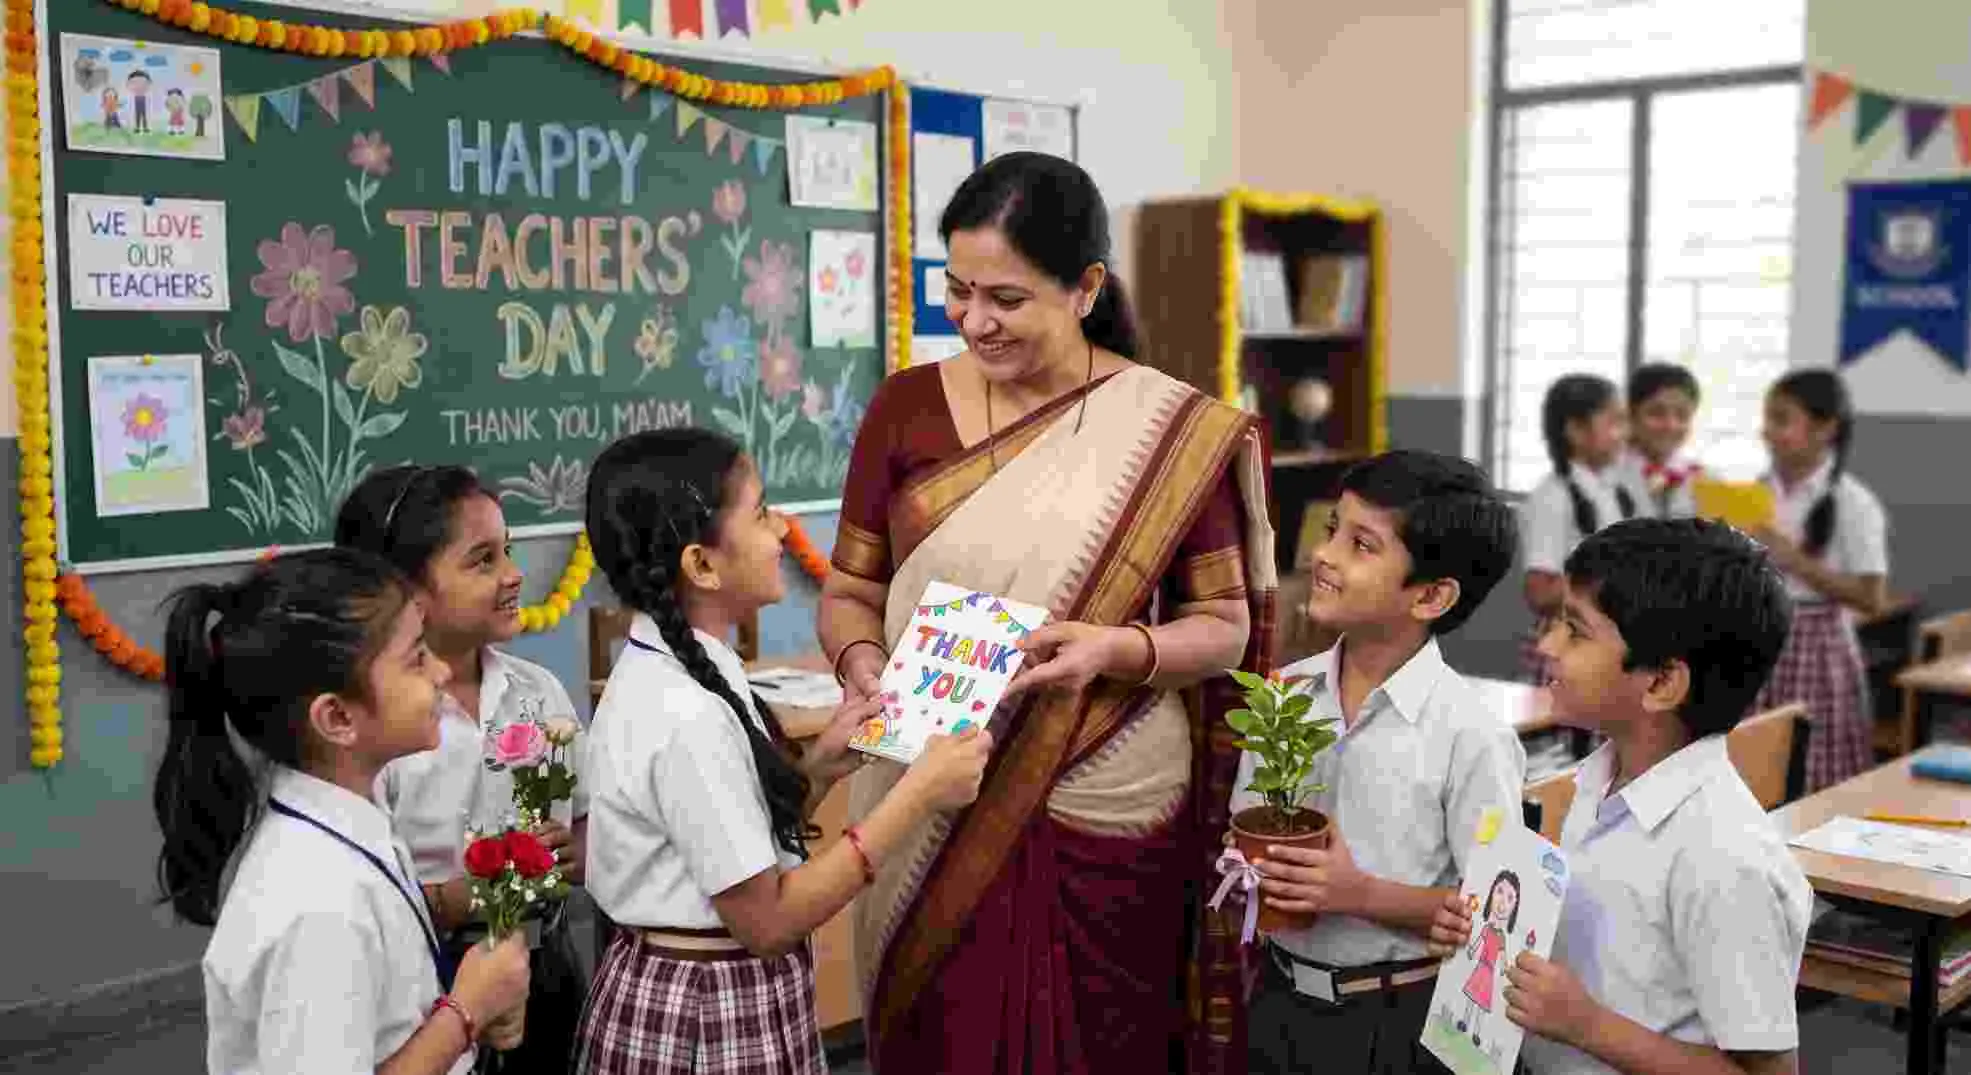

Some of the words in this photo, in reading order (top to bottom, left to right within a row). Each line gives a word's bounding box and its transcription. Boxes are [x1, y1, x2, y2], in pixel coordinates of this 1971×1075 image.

[448, 118, 648, 204] HAPPY
[88, 211, 127, 236] WE
[142, 213, 204, 238] LOVE
[127, 243, 174, 267] OUR
[88, 272, 214, 299] TEACHERS
[497, 301, 616, 379] DAY
[440, 407, 542, 445] THANK
[549, 404, 608, 442] YOU,
[916, 625, 1018, 675] THANK
[913, 666, 976, 704] YOU
